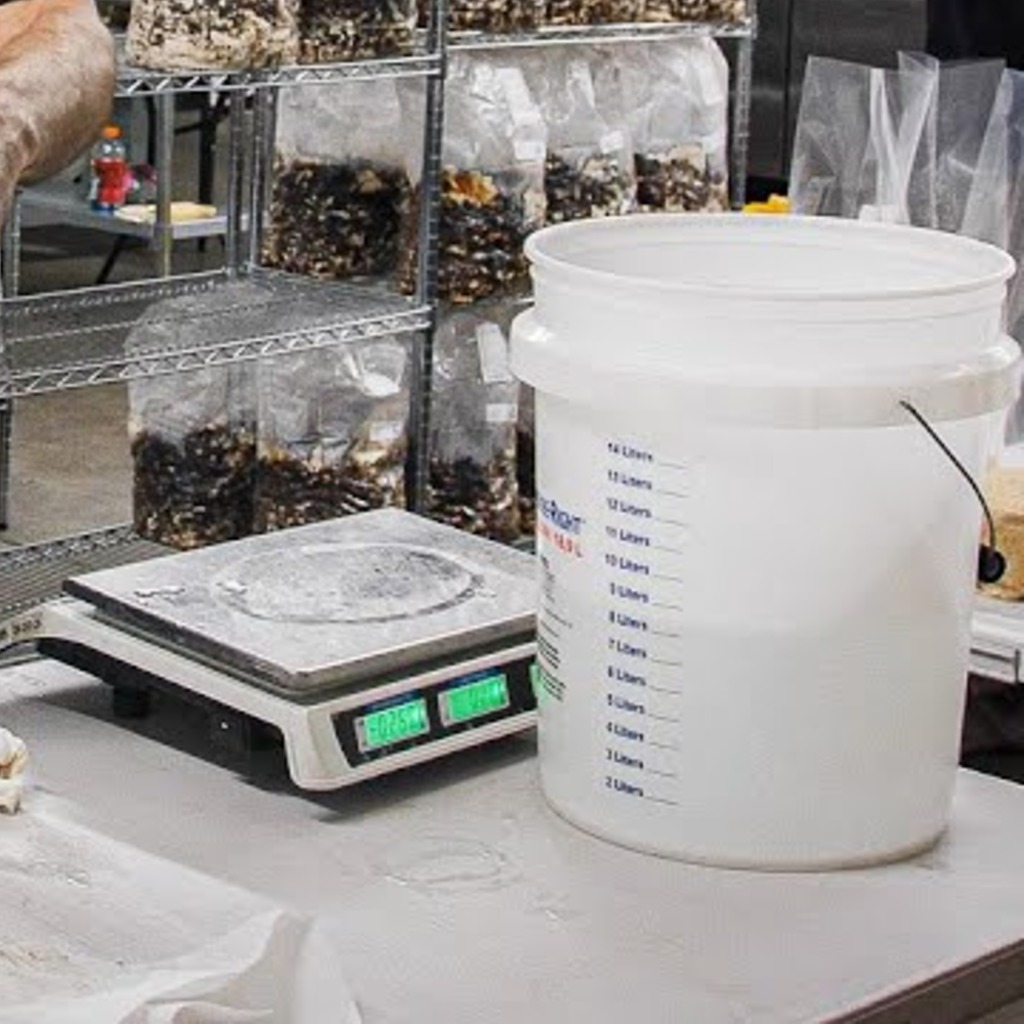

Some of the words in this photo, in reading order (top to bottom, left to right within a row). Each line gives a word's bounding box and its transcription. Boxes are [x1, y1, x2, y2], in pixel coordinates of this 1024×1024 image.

[622, 445, 653, 463] Liters
[622, 474, 652, 490] Liters
[619, 501, 652, 518] Liters
[620, 529, 649, 547] Liters
[620, 557, 649, 575] Liters
[617, 585, 649, 603] Liters
[617, 613, 647, 631] Liters
[617, 640, 647, 658] Liters
[617, 668, 647, 686] Liters
[615, 696, 645, 715] Liters
[614, 723, 644, 743] Liters
[614, 749, 644, 769] Liters
[614, 778, 643, 797] Liters
